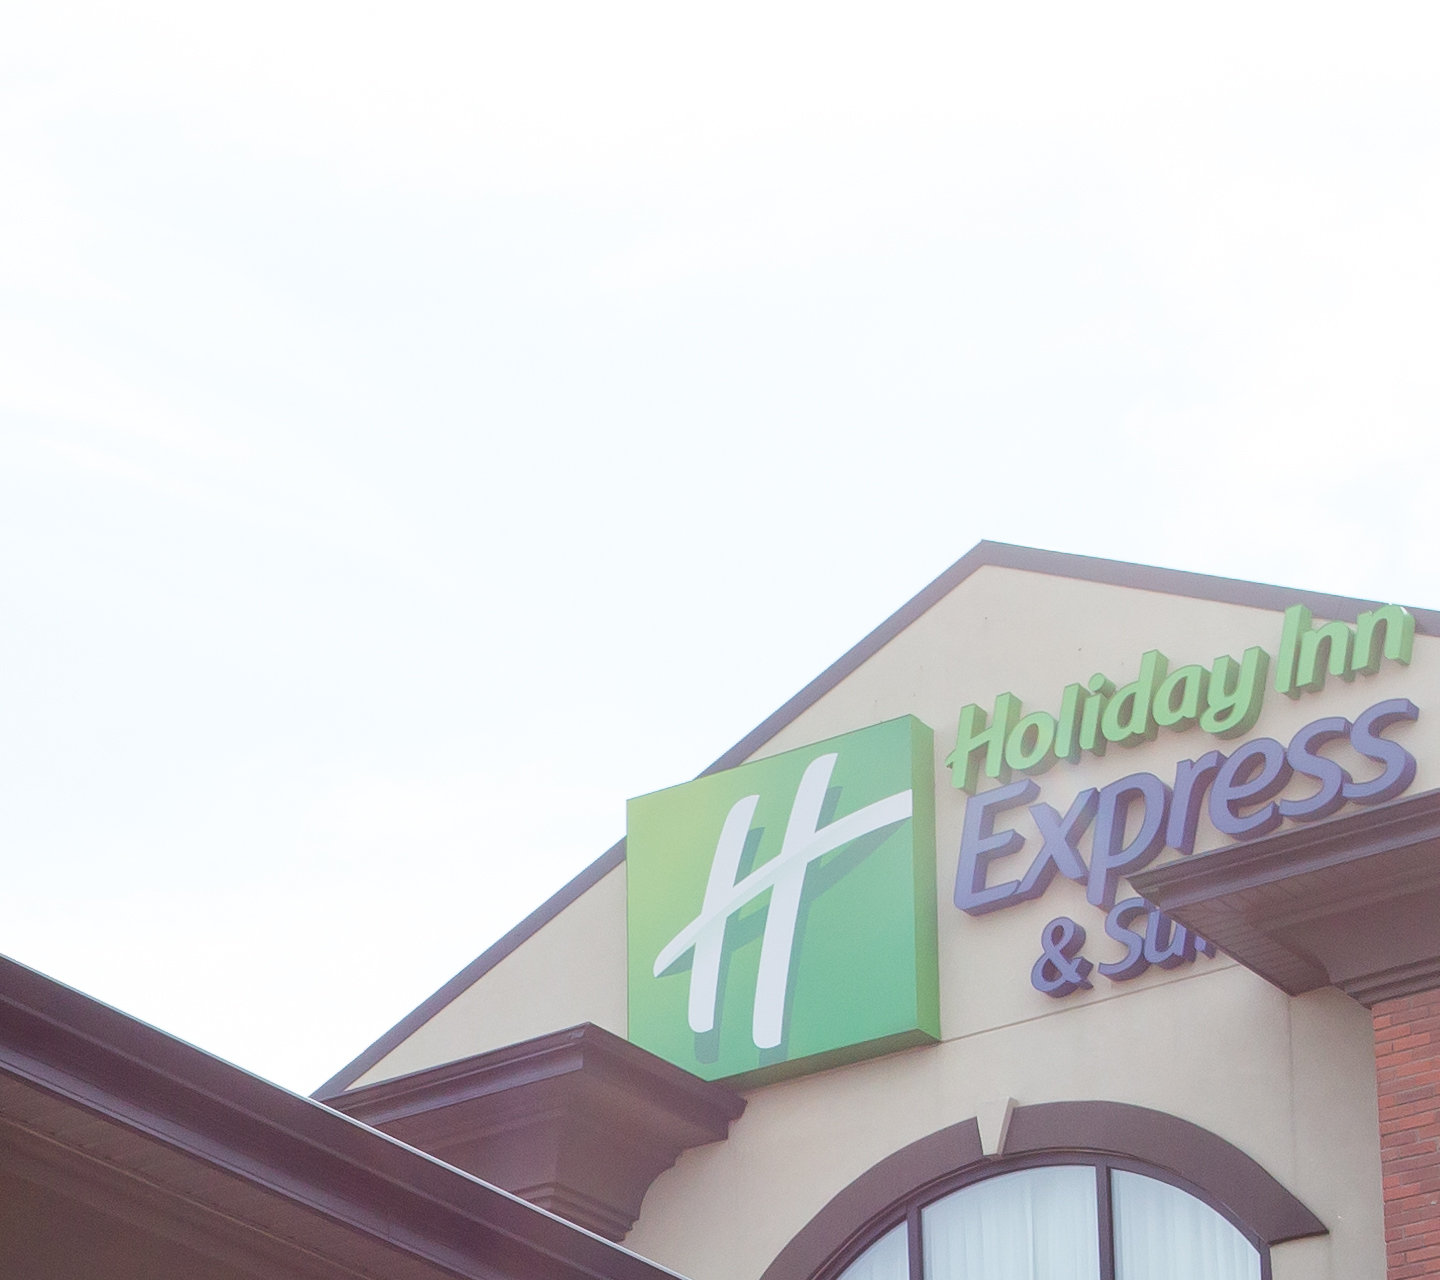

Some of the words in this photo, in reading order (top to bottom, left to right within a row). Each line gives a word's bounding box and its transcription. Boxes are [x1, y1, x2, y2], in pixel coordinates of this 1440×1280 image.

[945, 645, 1270, 795] Holiday
[1274, 603, 1416, 700] Inn
[953, 697, 1421, 917] Express
[1030, 916, 1094, 999] &
